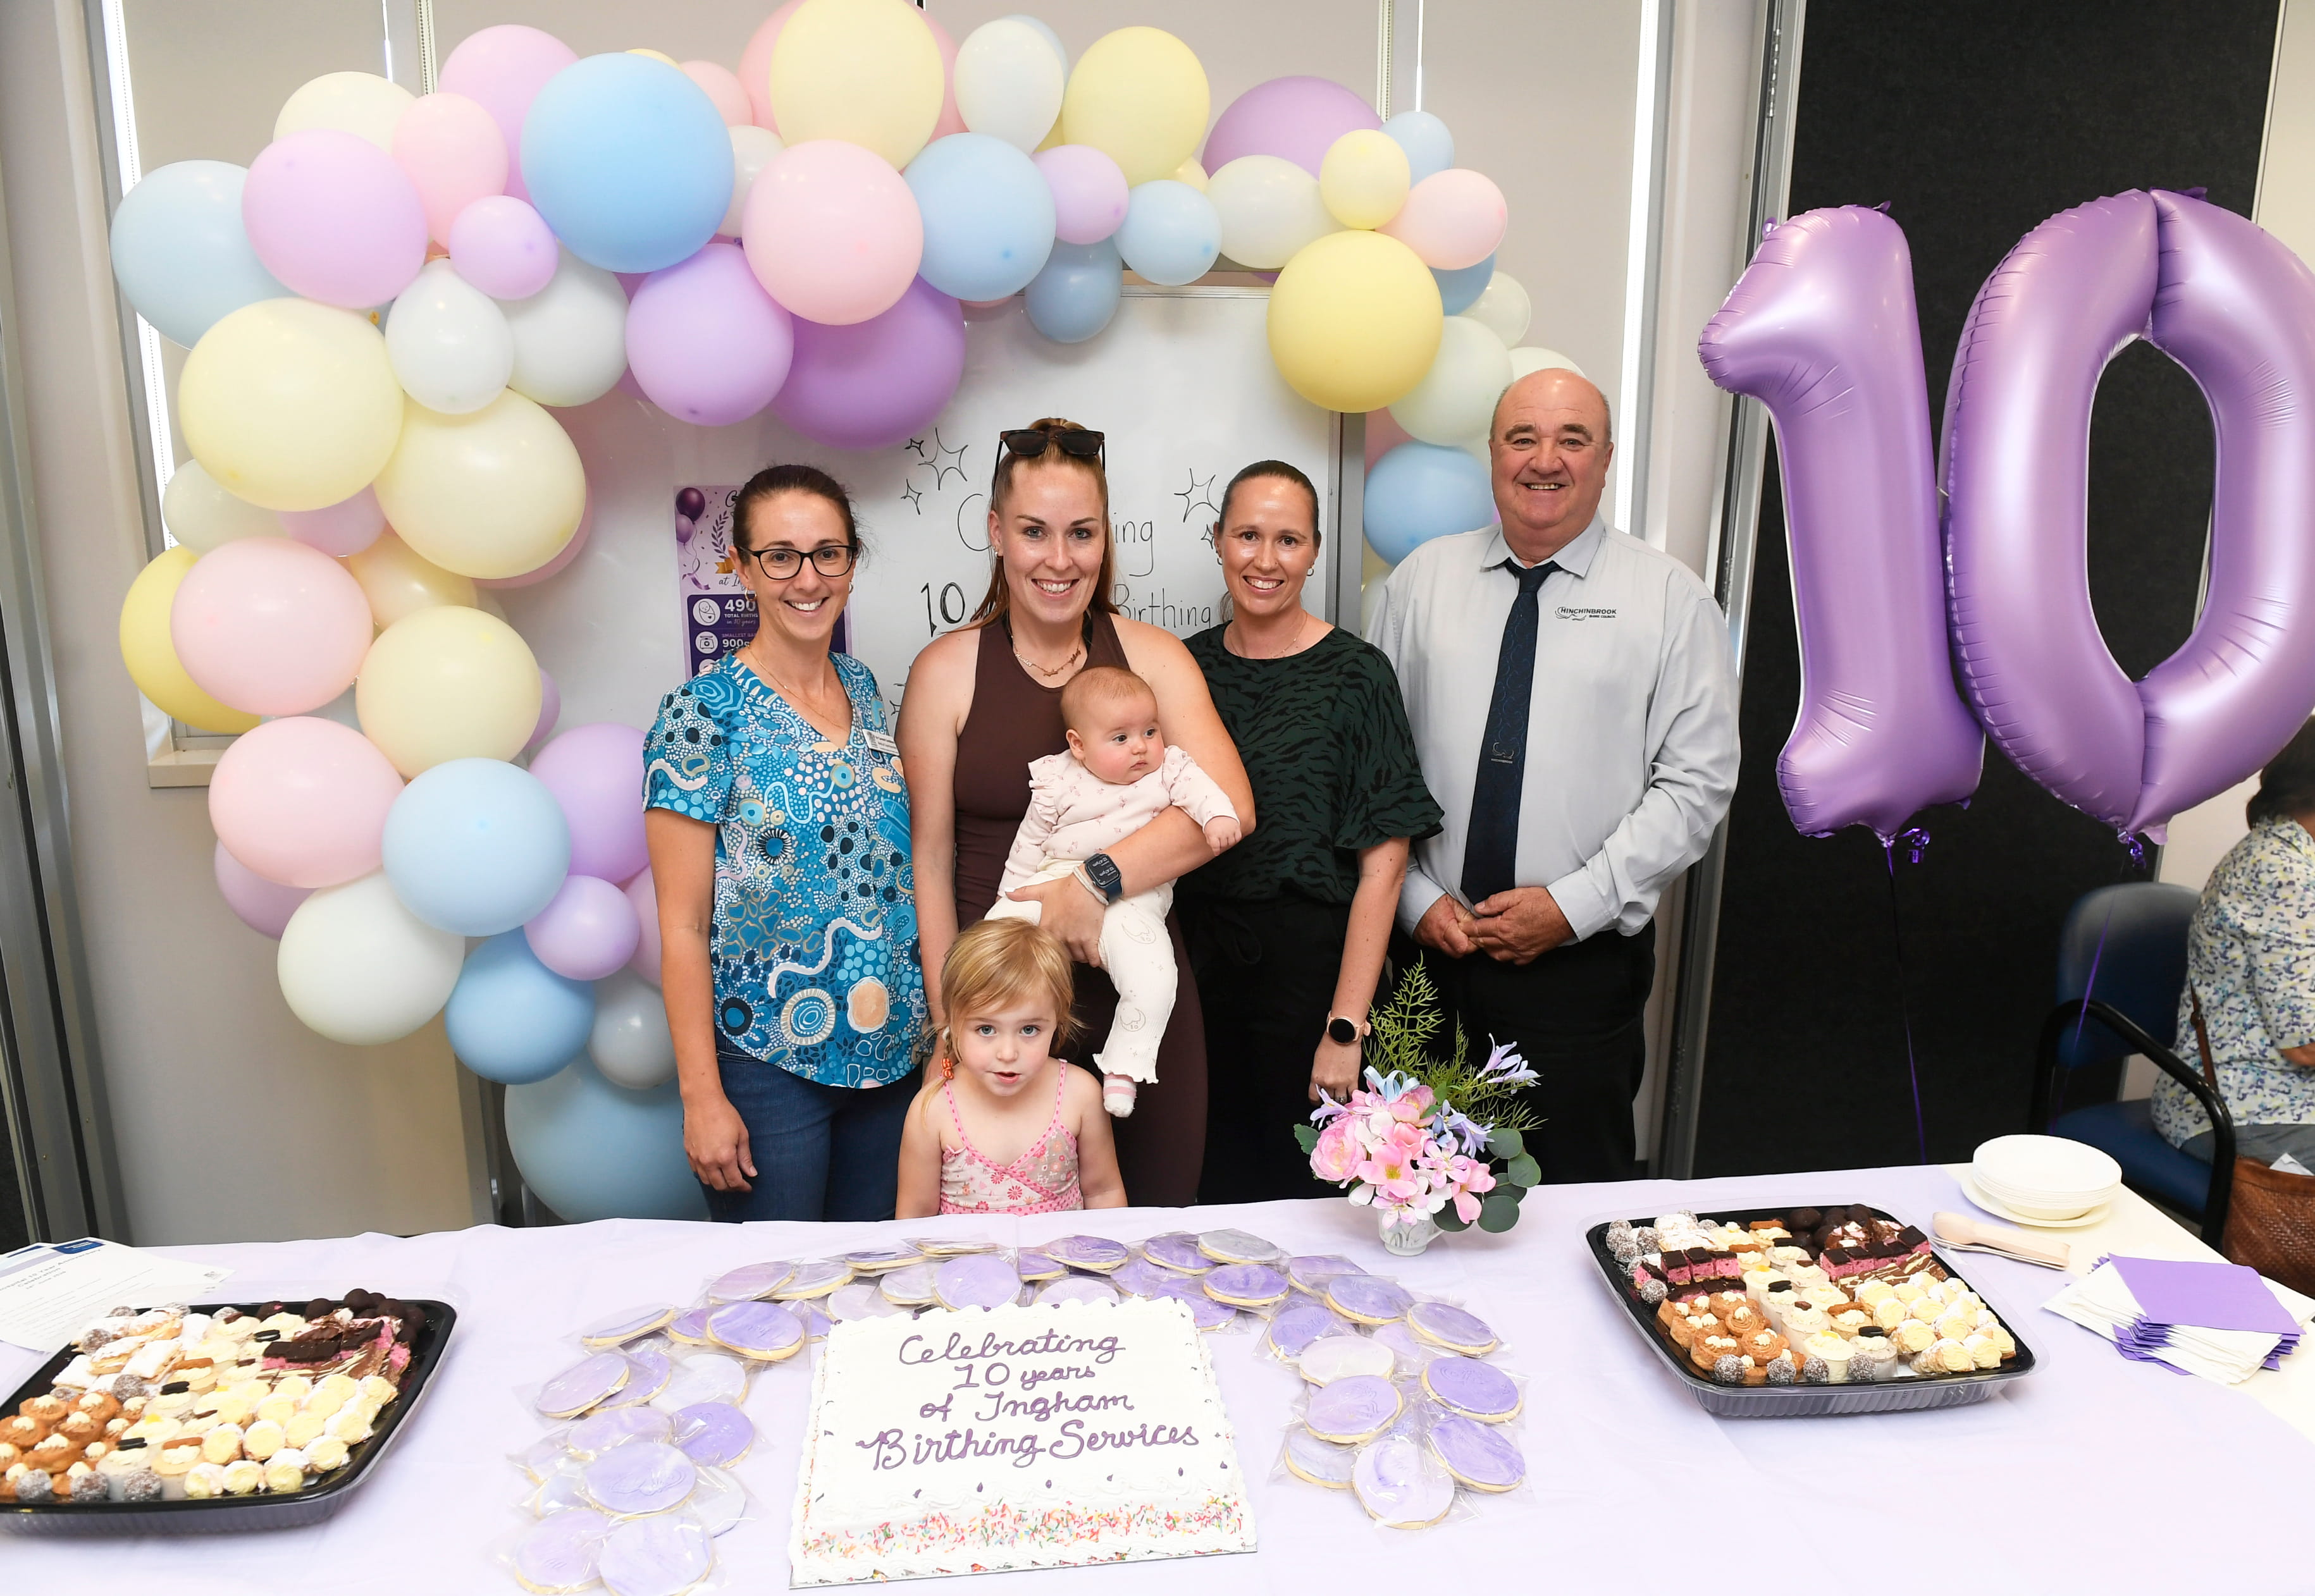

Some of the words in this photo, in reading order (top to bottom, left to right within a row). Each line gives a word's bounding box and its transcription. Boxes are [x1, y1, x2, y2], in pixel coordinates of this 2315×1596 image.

[1698, 188, 2315, 838] 10
[719, 576, 730, 586] at
[724, 599, 756, 612] 490
[920, 582, 966, 638] 10
[899, 1328, 1126, 1365] Celebrating
[953, 1362, 1010, 1390] 10
[1020, 1365, 1096, 1391] years
[920, 1392, 954, 1421] of
[975, 1390, 1135, 1421] Ingham
[855, 1428, 1046, 1471] Birthing
[1049, 1419, 1199, 1459] Services
